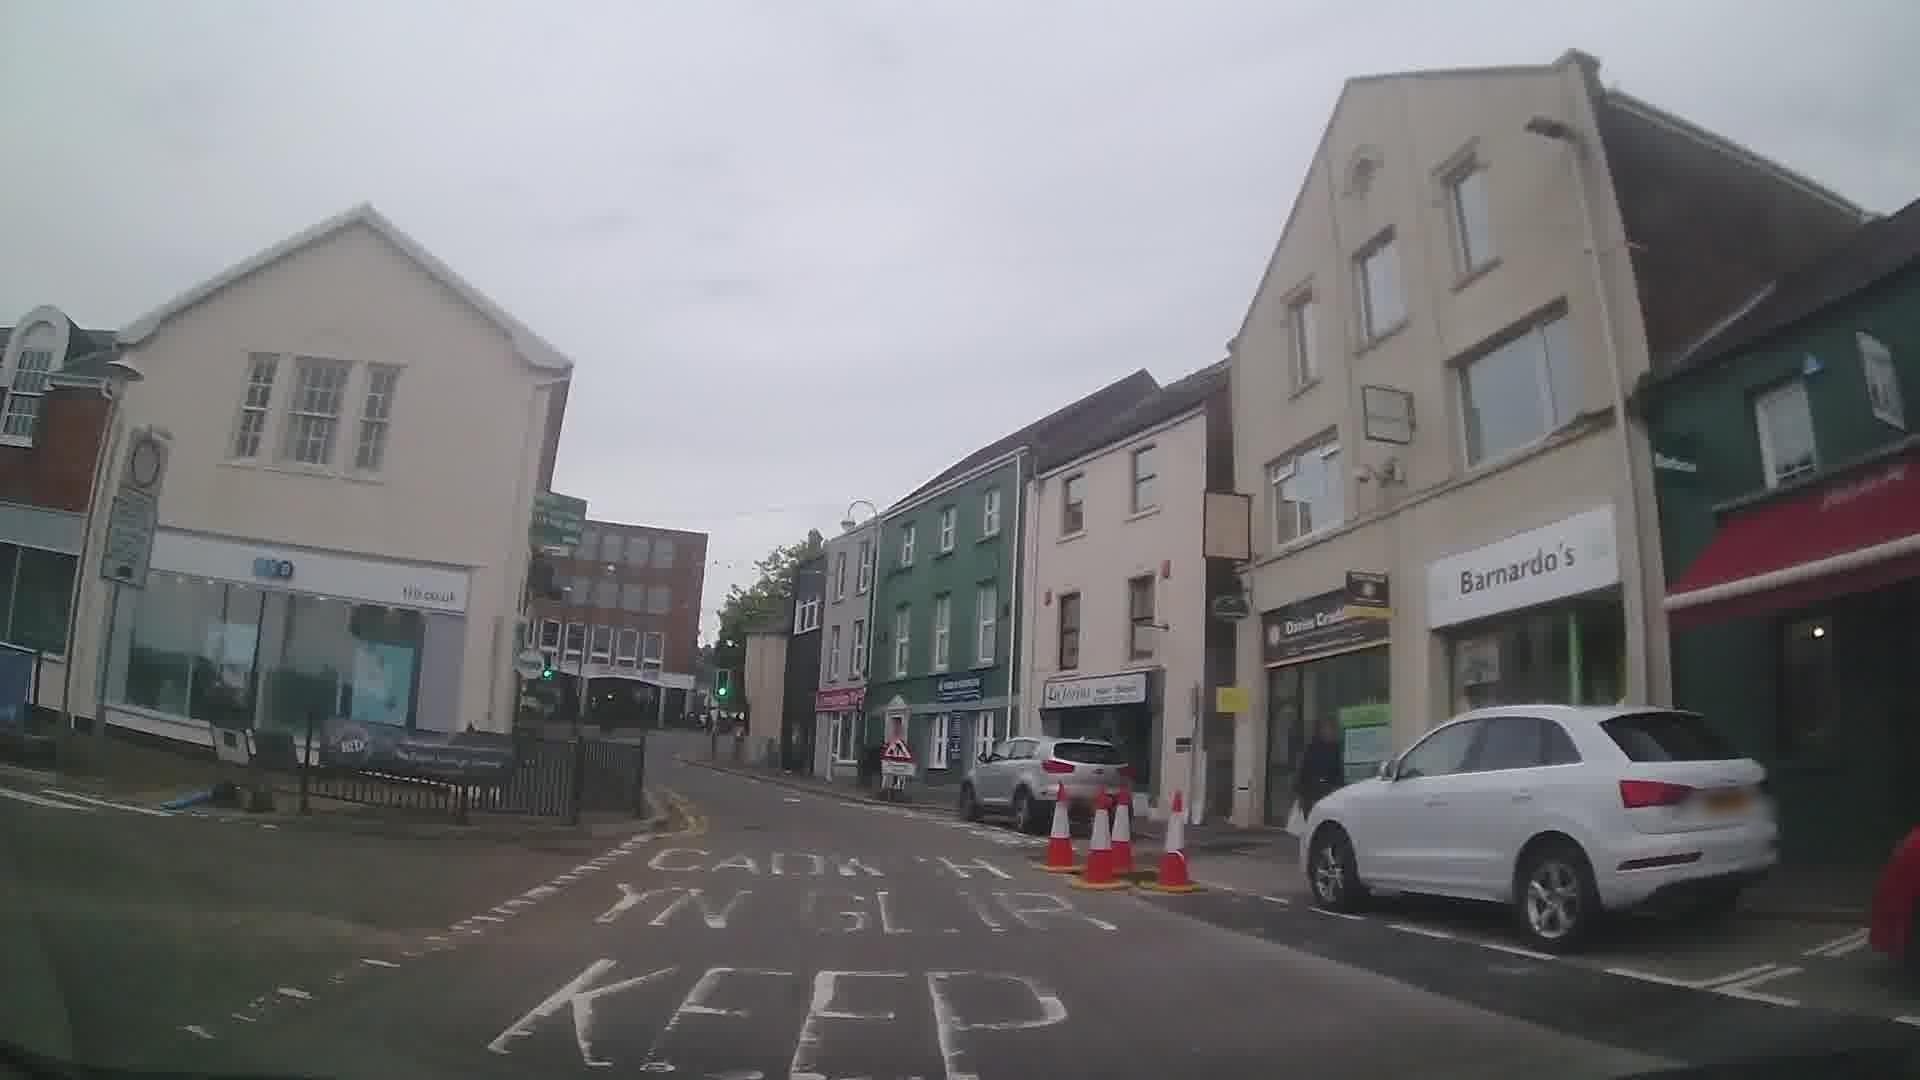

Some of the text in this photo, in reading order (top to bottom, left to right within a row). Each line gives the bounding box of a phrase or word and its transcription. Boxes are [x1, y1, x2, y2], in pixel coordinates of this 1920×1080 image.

[1458, 541, 1577, 596] Barnardo's
[595, 882, 774, 928] YN
[487, 957, 1070, 1080] KEEP
